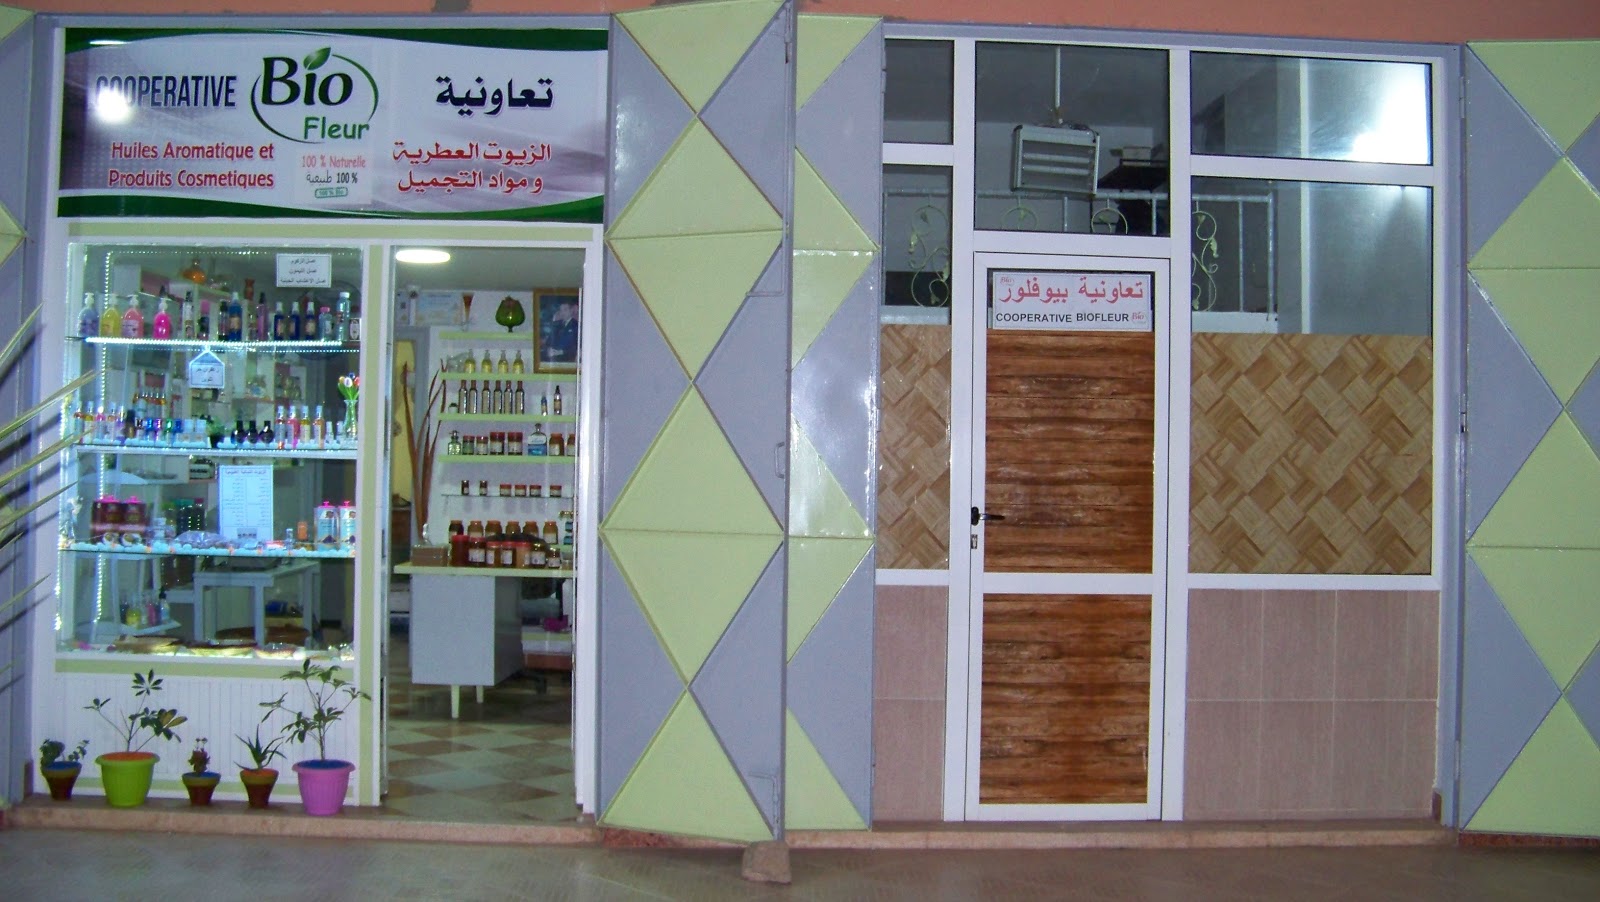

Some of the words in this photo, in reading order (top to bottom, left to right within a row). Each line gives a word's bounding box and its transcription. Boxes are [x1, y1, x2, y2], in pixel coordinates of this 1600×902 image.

[260, 50, 354, 106] Bio
[435, 76, 553, 116] تعاونية
[303, 117, 370, 140] Fleur
[111, 142, 158, 159] Huiles
[163, 142, 254, 161] Aromatique
[259, 143, 274, 159] et
[302, 155, 317, 168] 100
[329, 154, 366, 168] Naturelle
[393, 142, 479, 164] العطرية
[483, 142, 551, 165] الزيوت
[109, 170, 172, 187] Produits
[177, 170, 274, 189] Cosmetiques
[398, 170, 482, 193] التجميل
[1000, 277, 1069, 303] بيوفلور
[1078, 276, 1144, 303] تعاونية
[995, 312, 1072, 323] COOPERATIVE
[1076, 312, 1129, 322] BIOFLEUR
